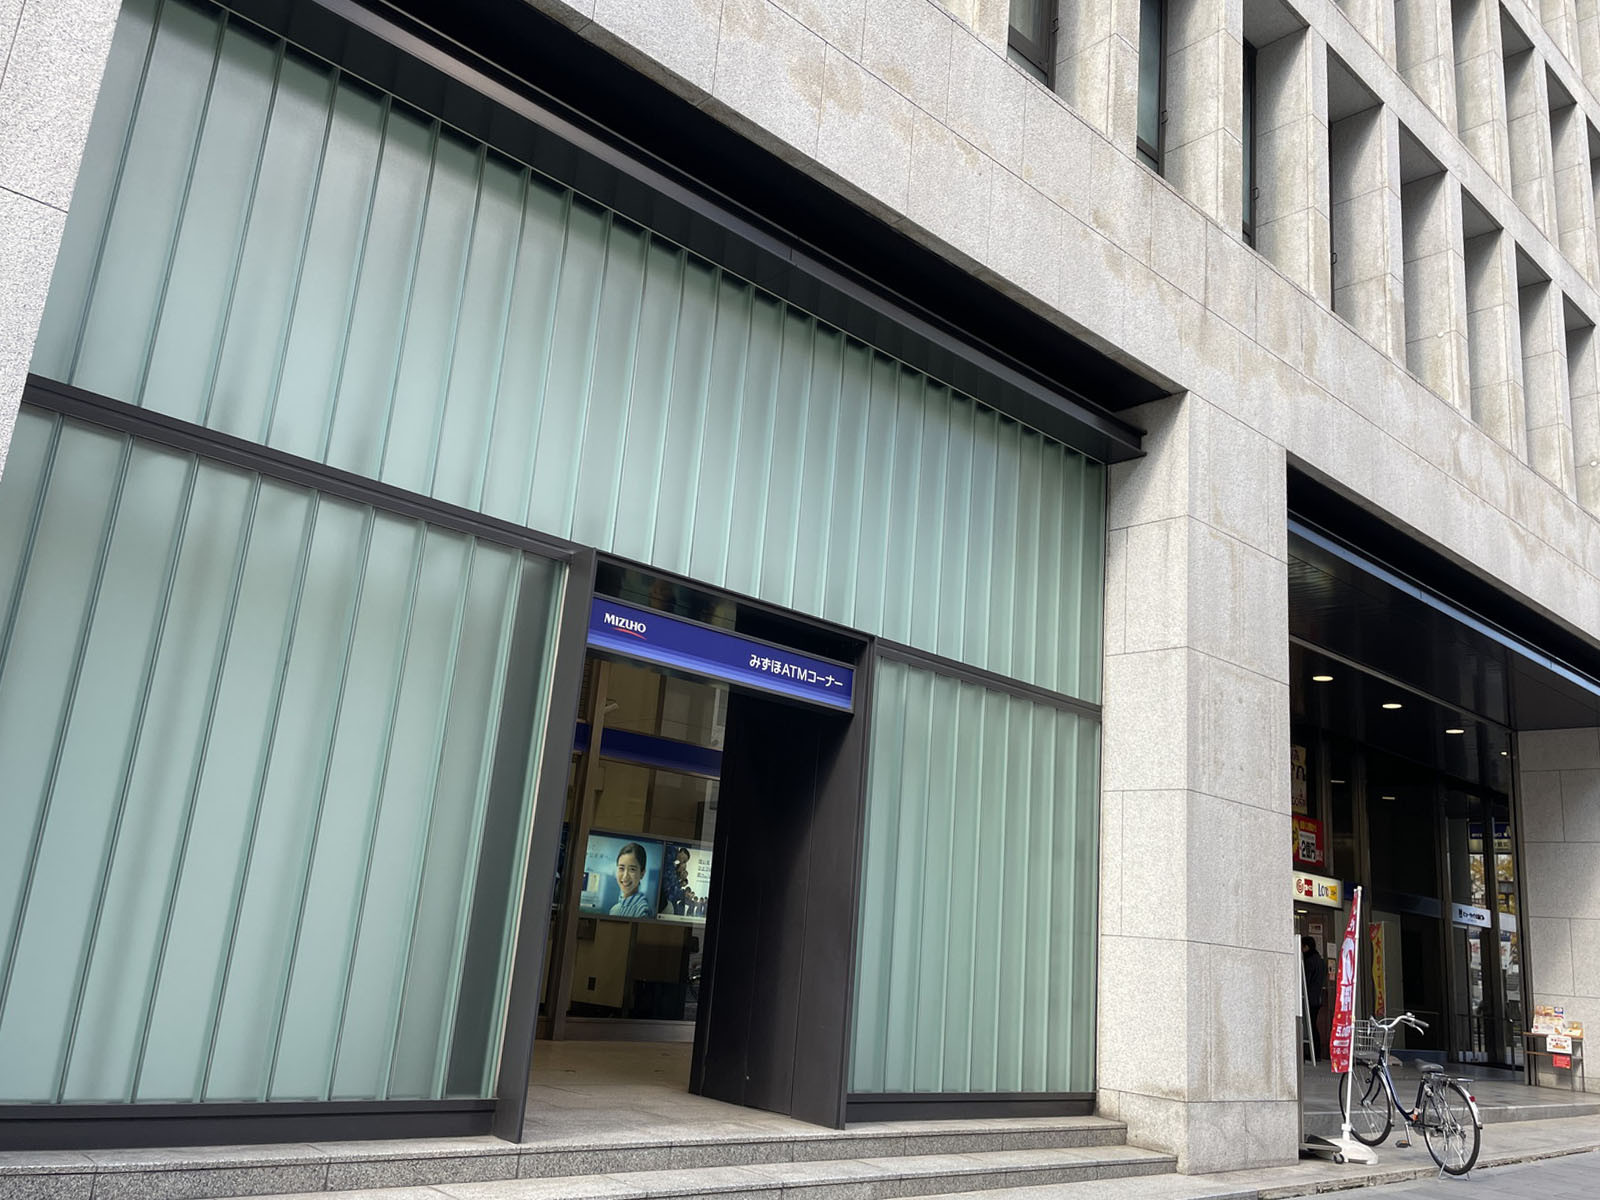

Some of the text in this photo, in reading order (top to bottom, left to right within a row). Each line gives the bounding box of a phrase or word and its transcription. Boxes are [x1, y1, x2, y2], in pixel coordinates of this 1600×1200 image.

[603, 612, 647, 634] MIZUHO
[749, 653, 844, 688] みずほATMコーナー
